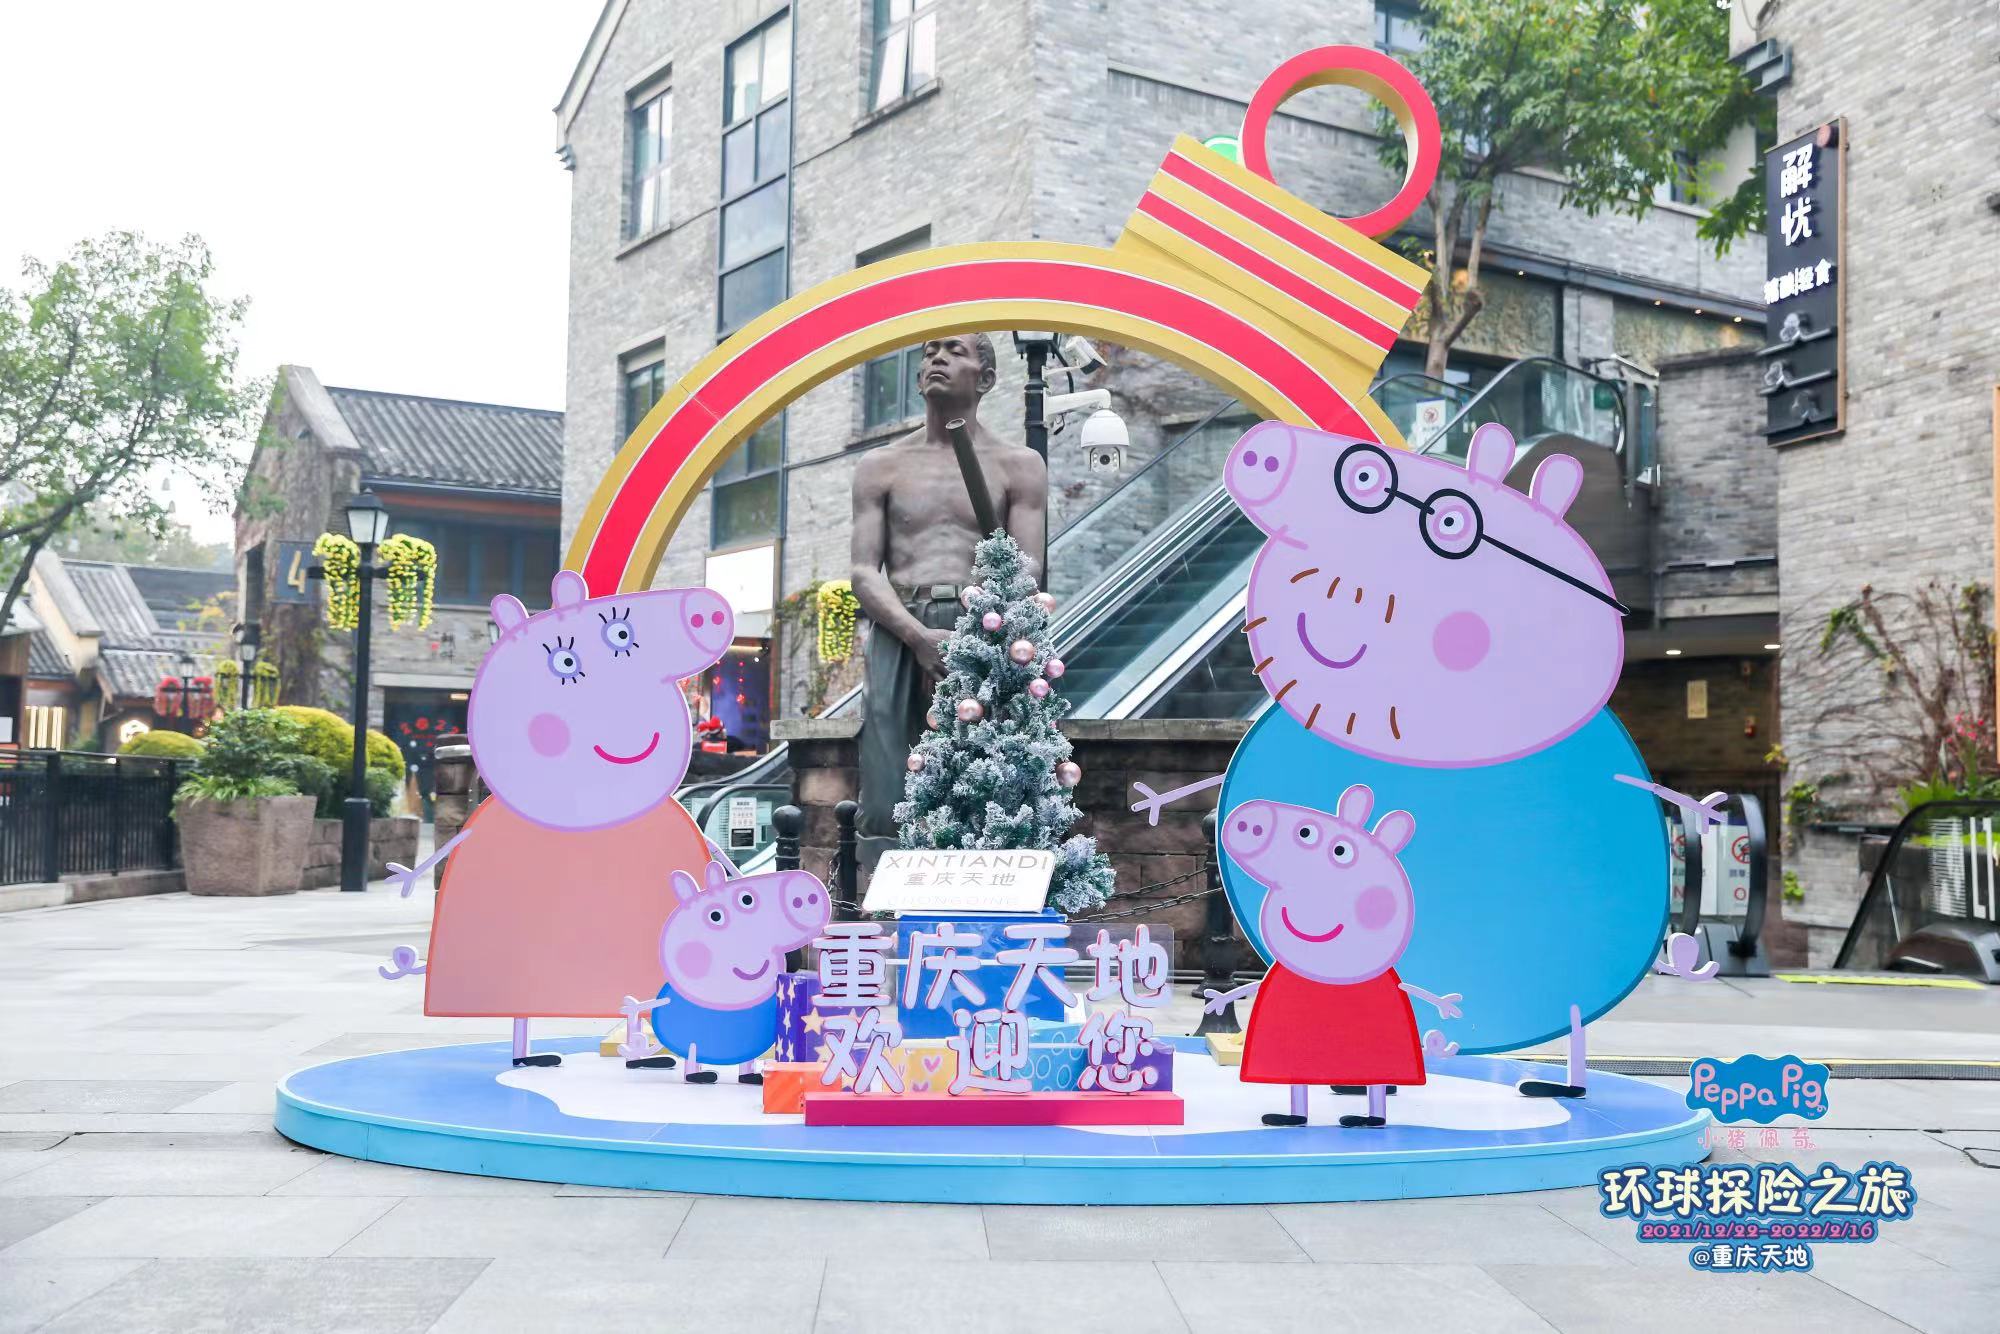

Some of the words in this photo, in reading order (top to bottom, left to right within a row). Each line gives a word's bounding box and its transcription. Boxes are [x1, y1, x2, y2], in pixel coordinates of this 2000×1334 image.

[1780, 142, 1813, 247] 解忧
[287, 550, 306, 595] 4
[886, 854, 1049, 870] XINTIANDI
[903, 872, 1017, 886] 重庆天地
[811, 922, 1173, 1010] 重庆天地
[820, 1006, 1158, 1096] 欢迎您
